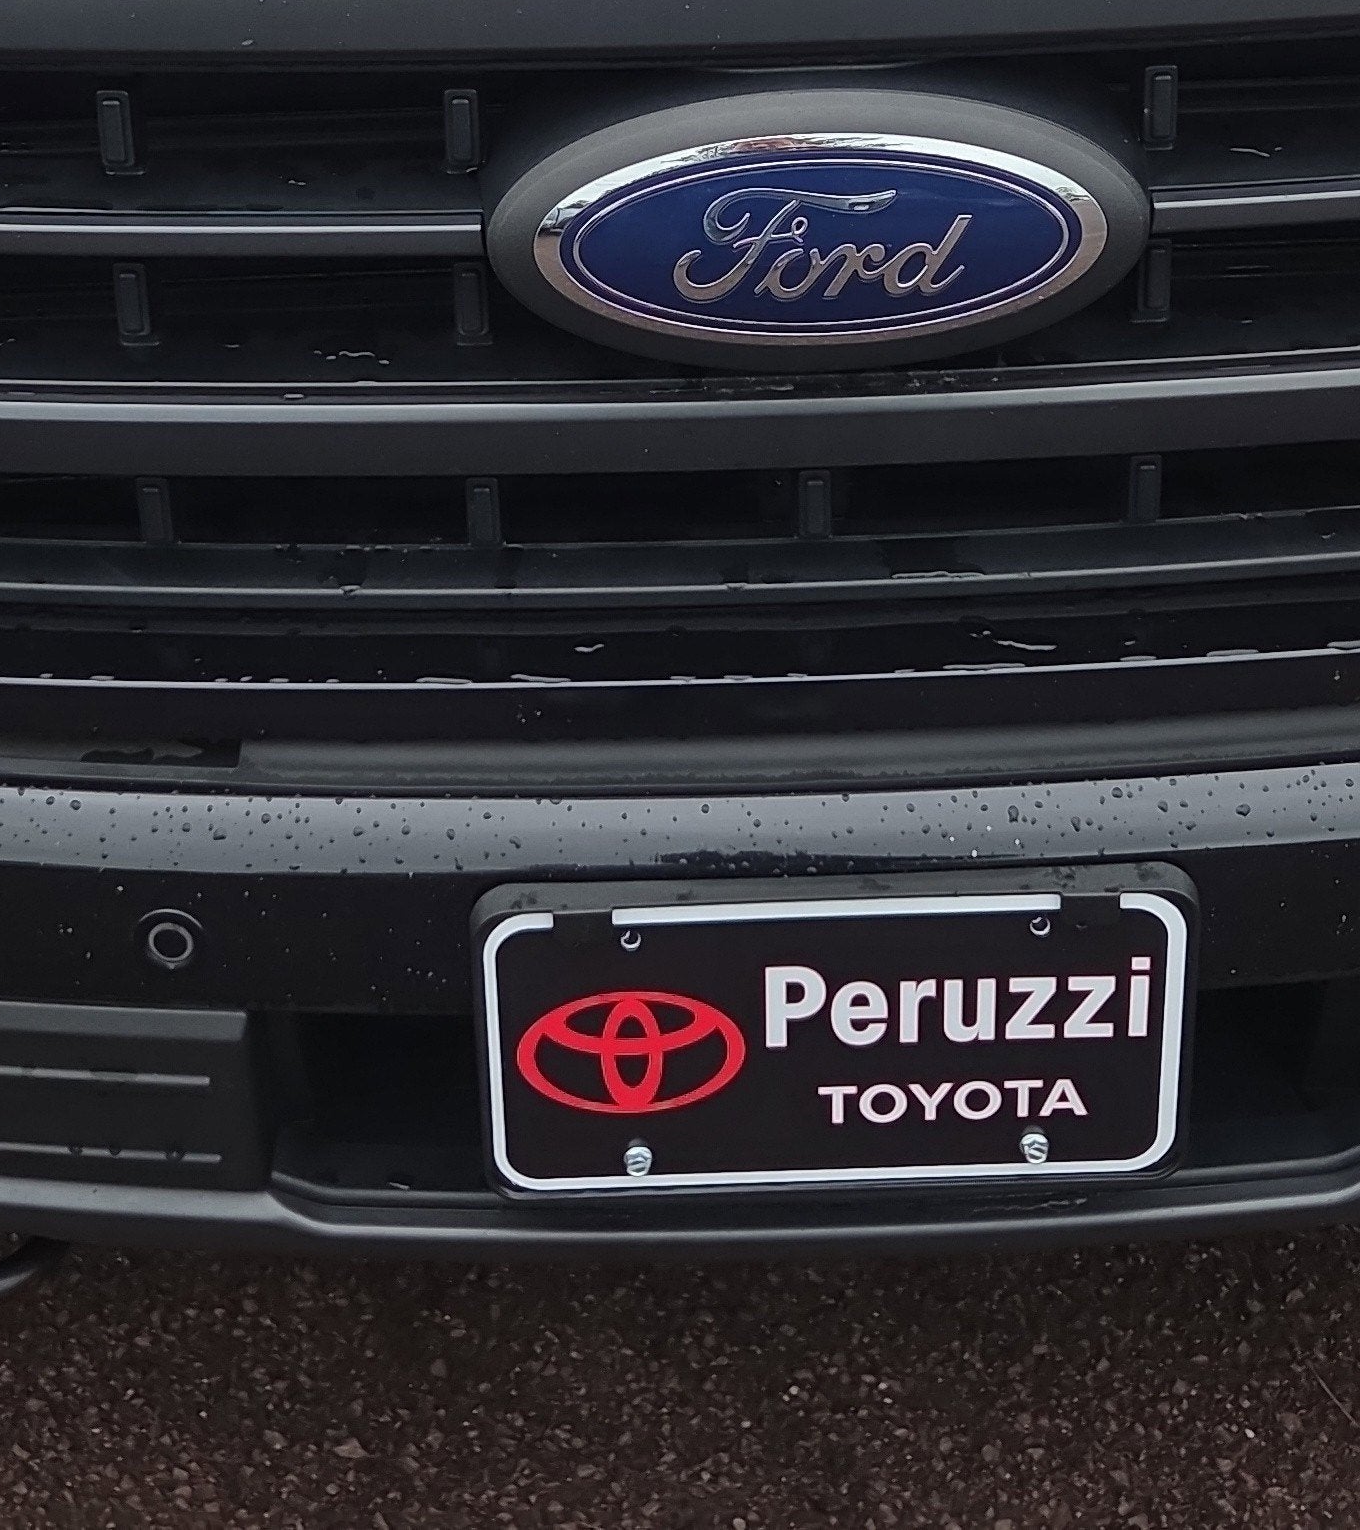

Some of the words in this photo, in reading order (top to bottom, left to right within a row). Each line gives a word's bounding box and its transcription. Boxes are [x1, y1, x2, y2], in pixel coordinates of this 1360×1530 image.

[672, 185, 973, 304] Ford
[763, 955, 1153, 1049] Peruzzi
[818, 1077, 1089, 1125] TOYOTA
